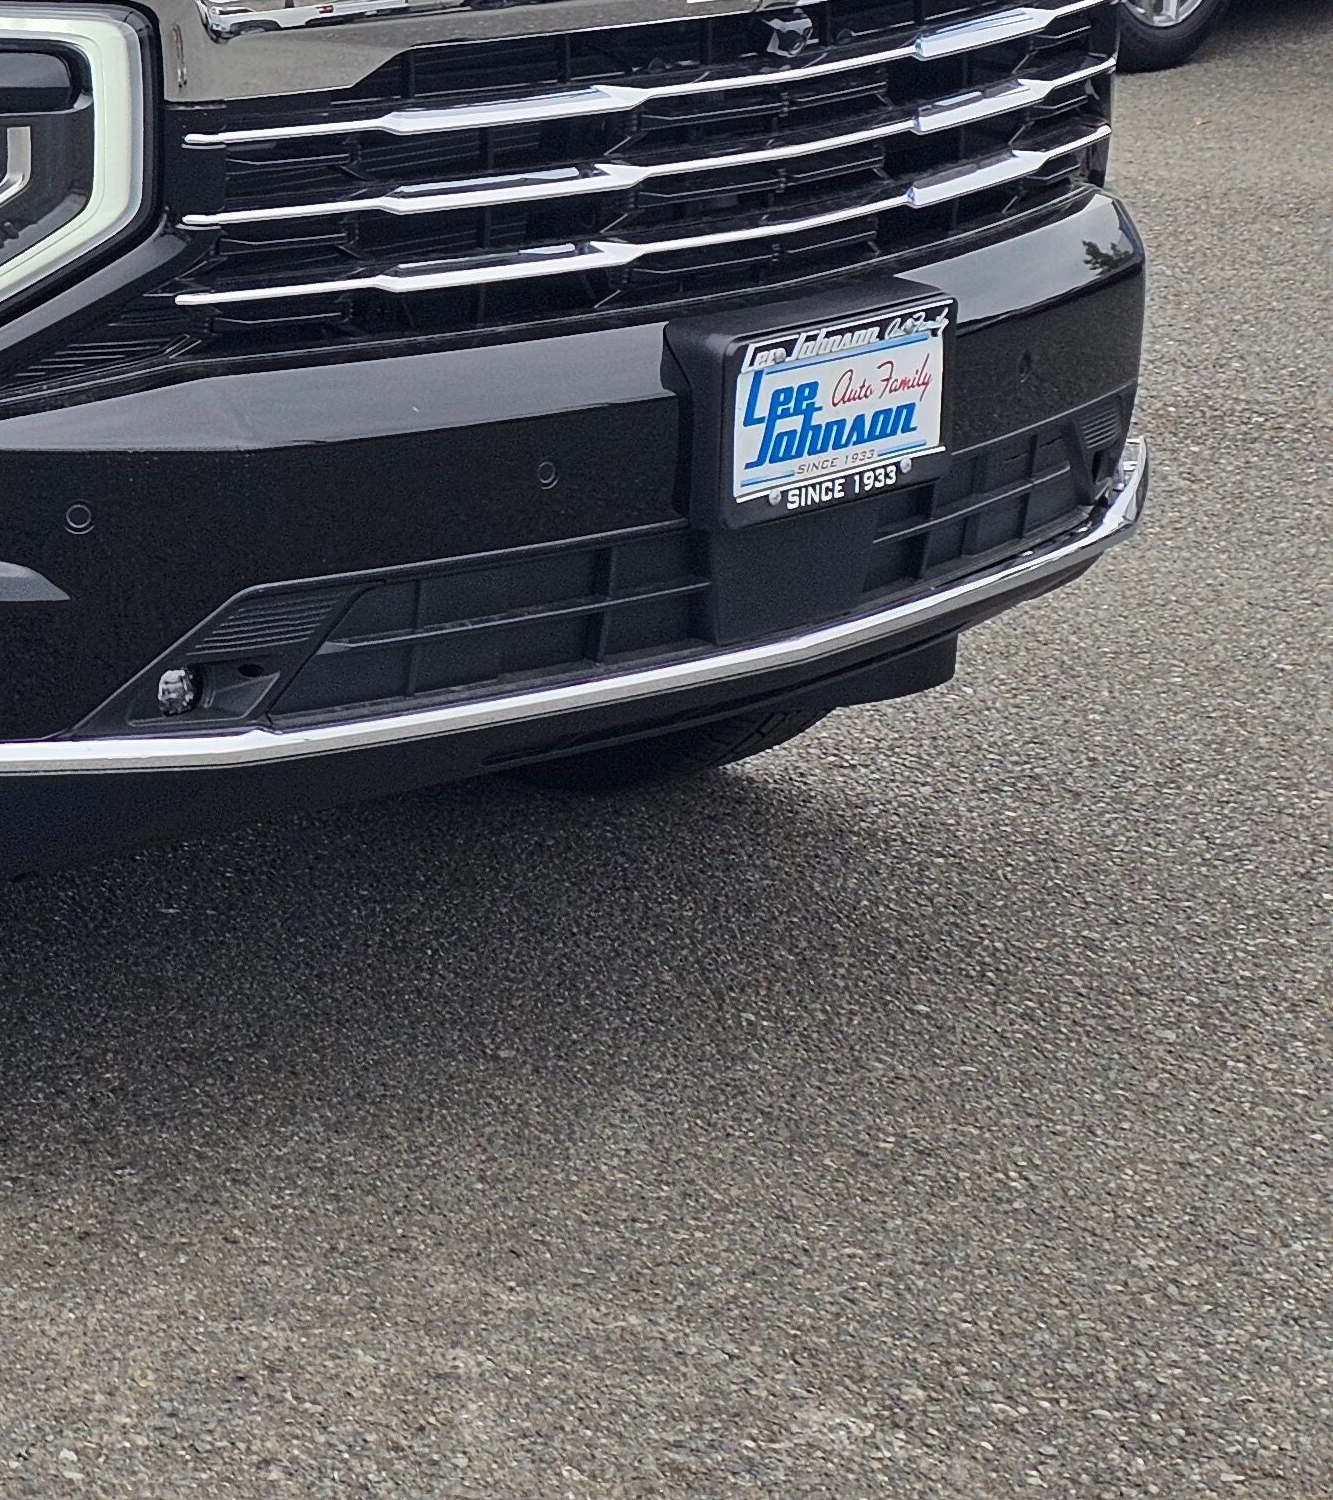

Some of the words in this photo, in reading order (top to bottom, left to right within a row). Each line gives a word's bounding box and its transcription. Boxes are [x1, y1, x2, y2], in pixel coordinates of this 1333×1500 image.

[786, 326, 881, 362] Johnson
[743, 369, 820, 427] Lee
[831, 368, 874, 408] Auto
[876, 352, 933, 402] Family
[744, 400, 918, 470] Johnson
[796, 457, 837, 475] SINCE
[844, 449, 875, 465] 1933
[786, 479, 846, 510] SINCE
[853, 465, 897, 493] 1933
